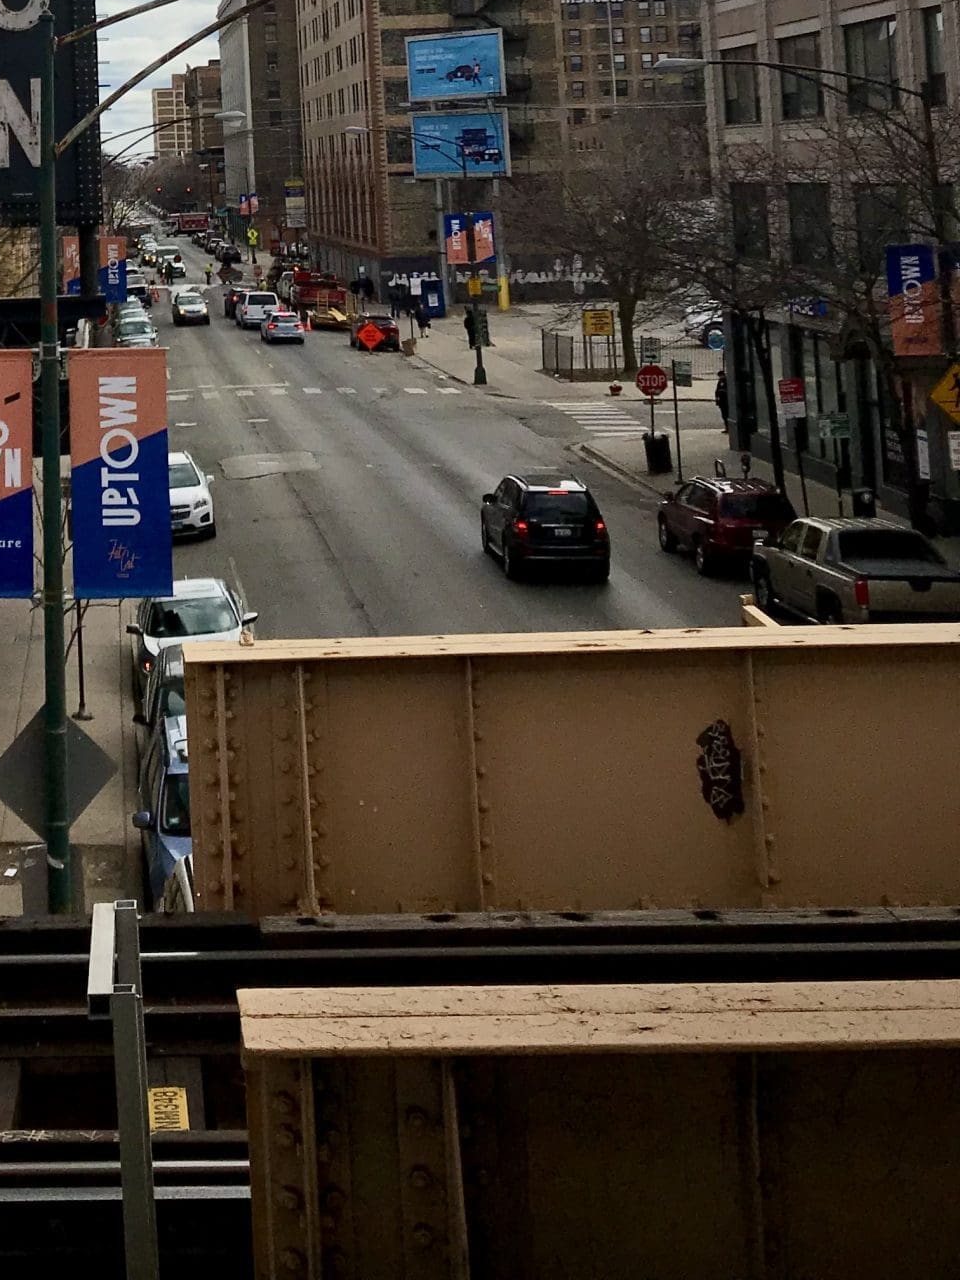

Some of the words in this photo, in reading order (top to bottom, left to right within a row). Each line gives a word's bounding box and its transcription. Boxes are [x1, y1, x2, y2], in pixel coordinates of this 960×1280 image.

[107, 243, 120, 285] UPTOWN
[638, 376, 666, 387] STOP
[97, 376, 142, 527] UPTOWN
